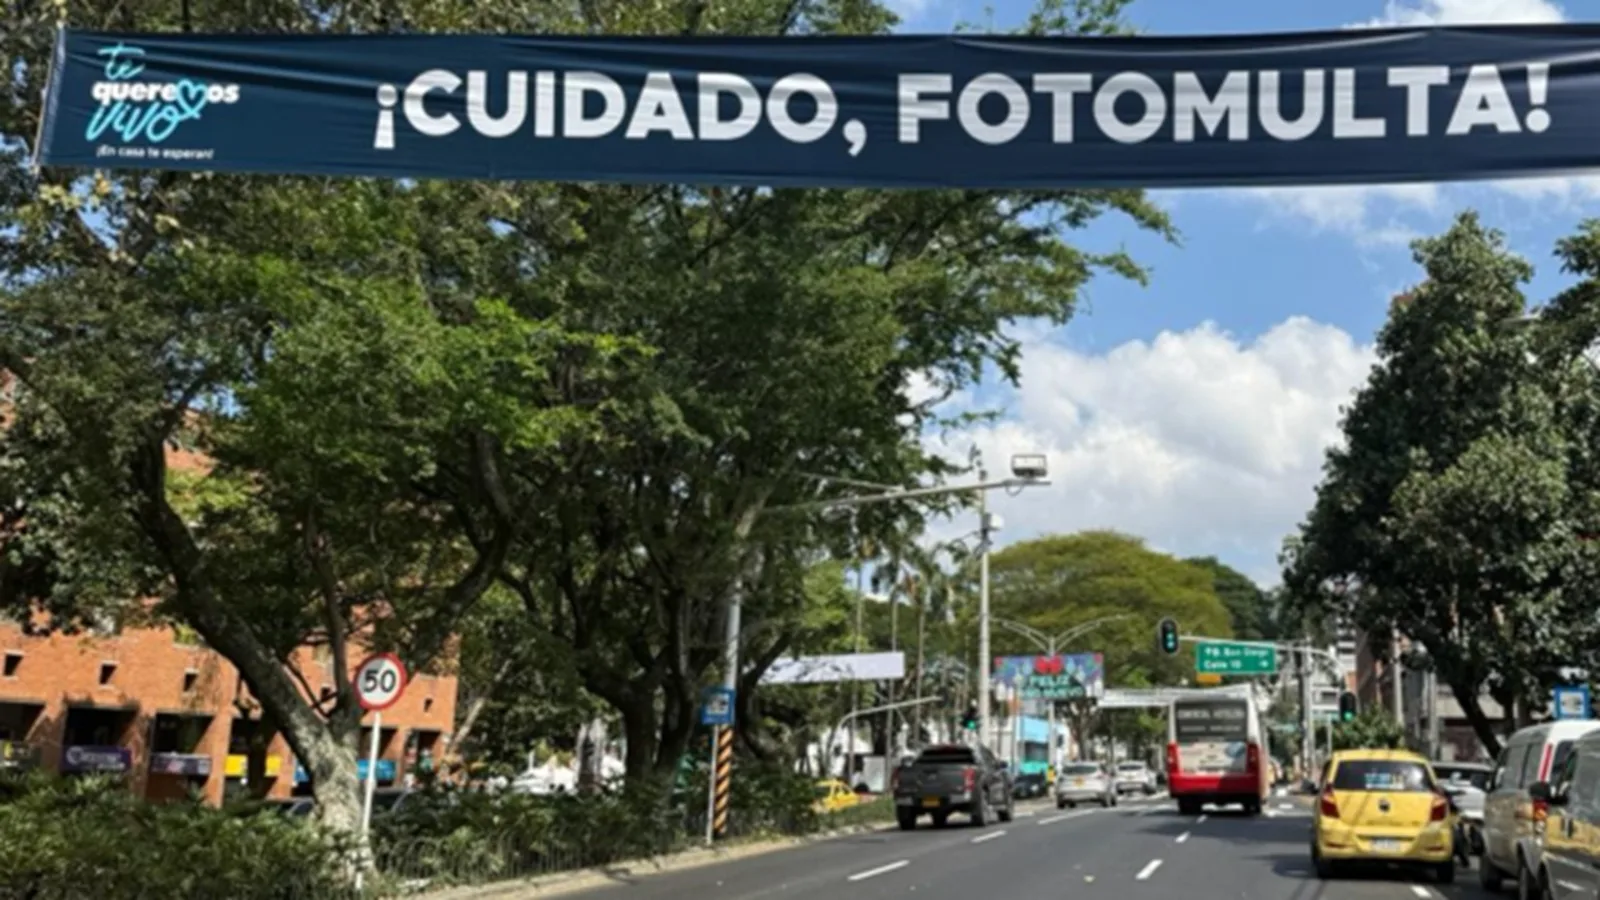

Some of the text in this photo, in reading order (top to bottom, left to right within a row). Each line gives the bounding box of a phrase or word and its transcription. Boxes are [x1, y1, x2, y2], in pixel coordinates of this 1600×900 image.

[98, 43, 146, 79] te
[374, 63, 1551, 157] ¡CUIDADO, FOTOMULTA!
[118, 147, 146, 157] casa
[148, 148, 160, 158] te
[363, 668, 397, 693] 50
